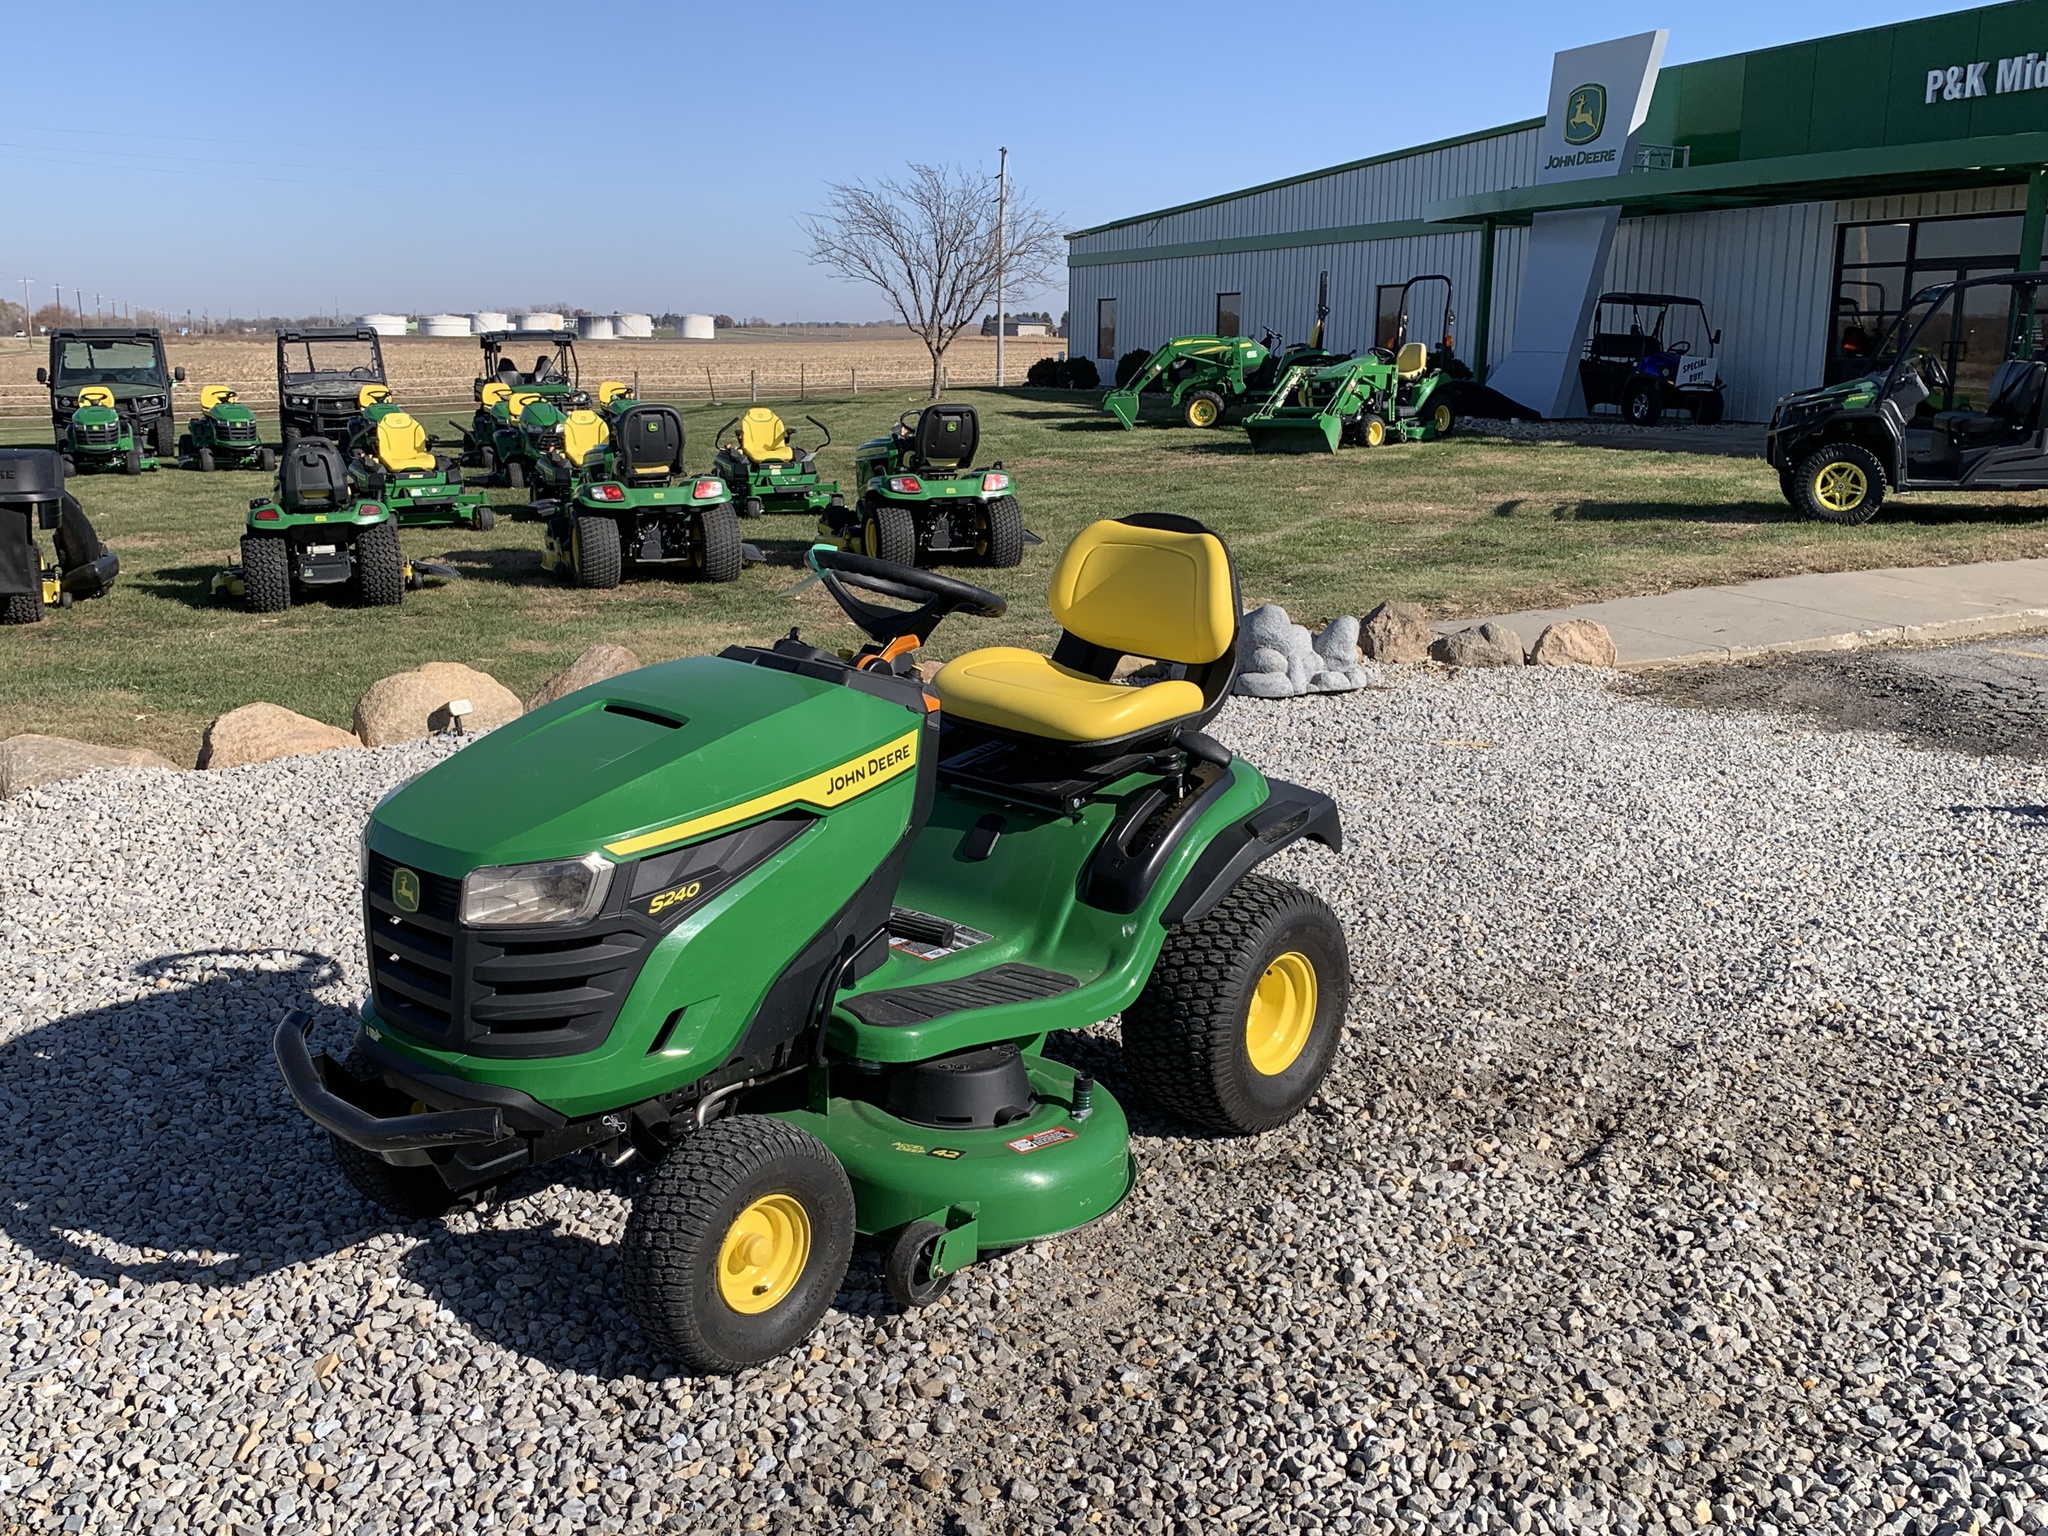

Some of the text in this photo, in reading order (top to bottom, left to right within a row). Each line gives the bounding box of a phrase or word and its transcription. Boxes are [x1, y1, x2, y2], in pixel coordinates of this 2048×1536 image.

[1925, 52, 2048, 104] P&K Mid
[1544, 149, 1616, 170] JOHN DEERE
[1682, 358, 1707, 373] SPECIAL
[826, 744, 910, 795] JOHN DEERE
[648, 882, 701, 914] S240
[932, 1149, 961, 1159] 42
